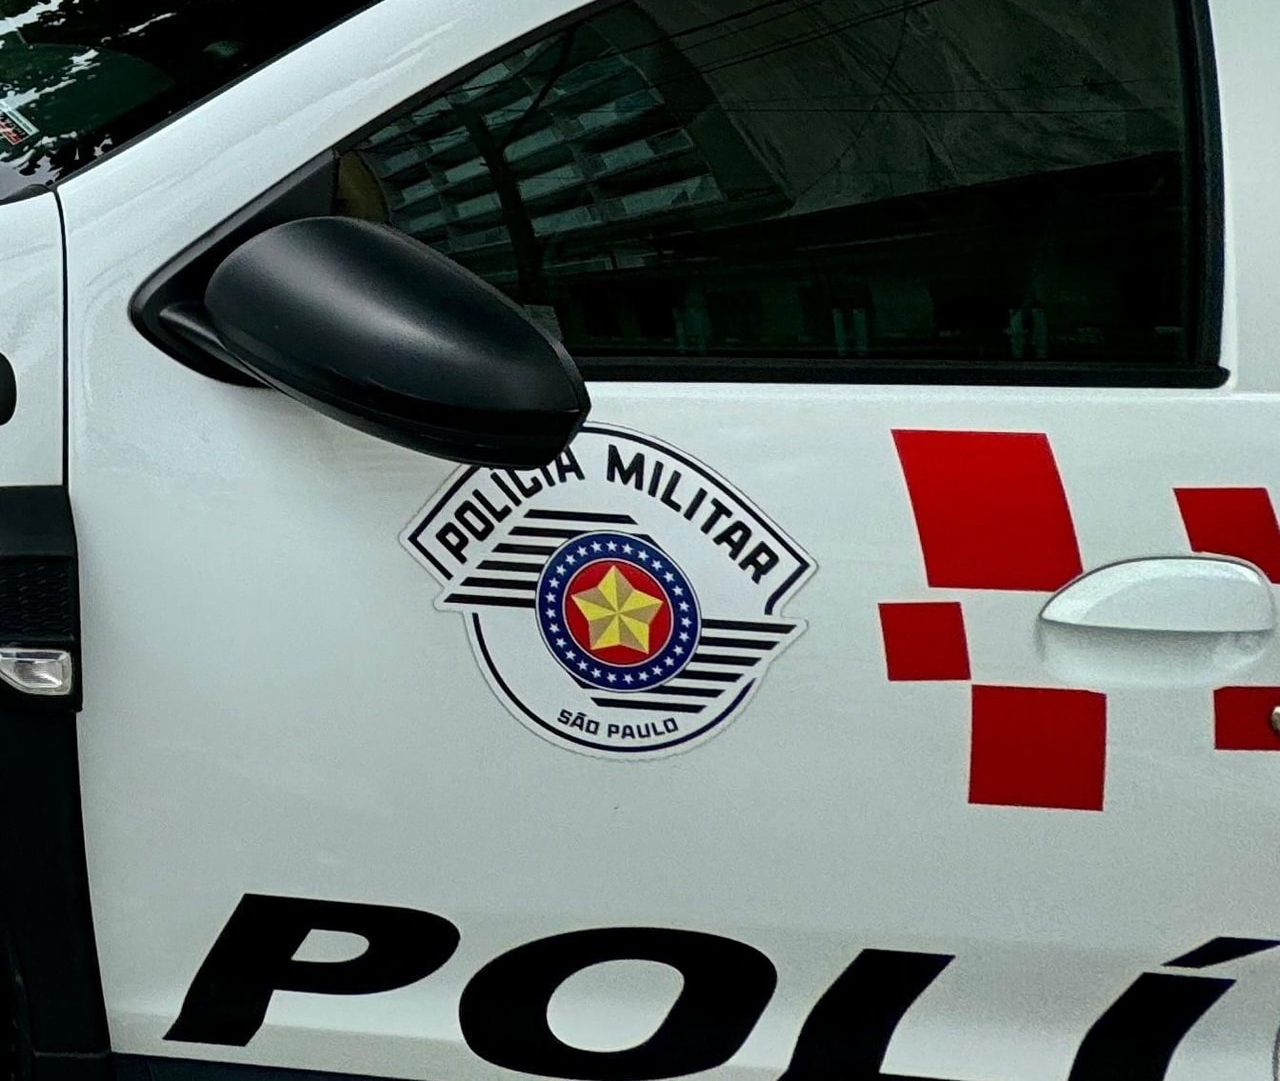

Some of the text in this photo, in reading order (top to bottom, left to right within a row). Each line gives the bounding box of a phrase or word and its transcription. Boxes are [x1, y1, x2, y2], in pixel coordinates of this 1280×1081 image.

[606, 443, 780, 585] MILITAR
[557, 709, 679, 740] SÃO PAULO
